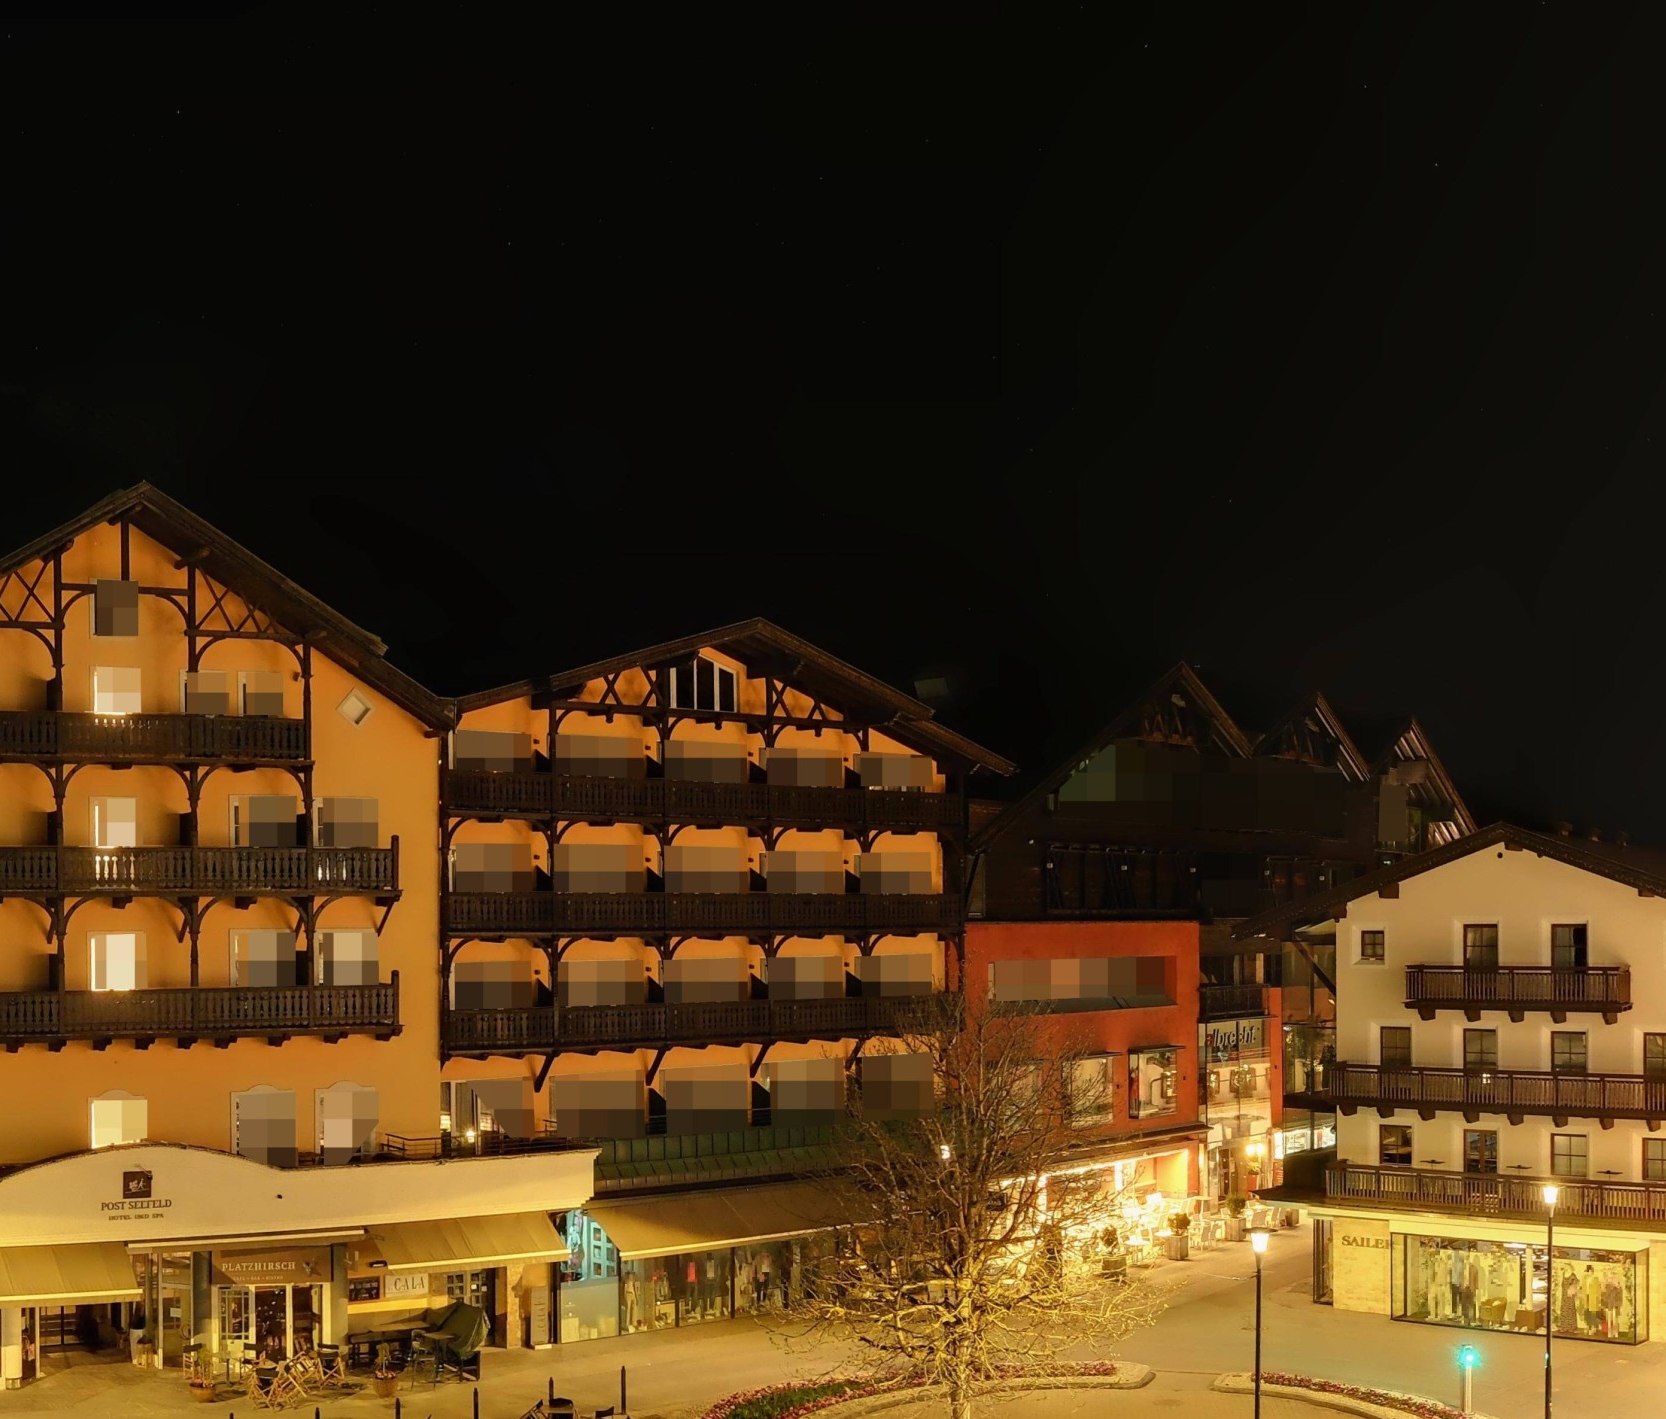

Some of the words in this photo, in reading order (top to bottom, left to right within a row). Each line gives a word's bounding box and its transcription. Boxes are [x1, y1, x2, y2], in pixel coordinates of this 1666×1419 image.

[101, 1201, 127, 1211] POST
[129, 1199, 172, 1209] SEEFELD
[222, 1261, 296, 1271] PLATZHIRSCH
[394, 1276, 425, 1292] CALA
